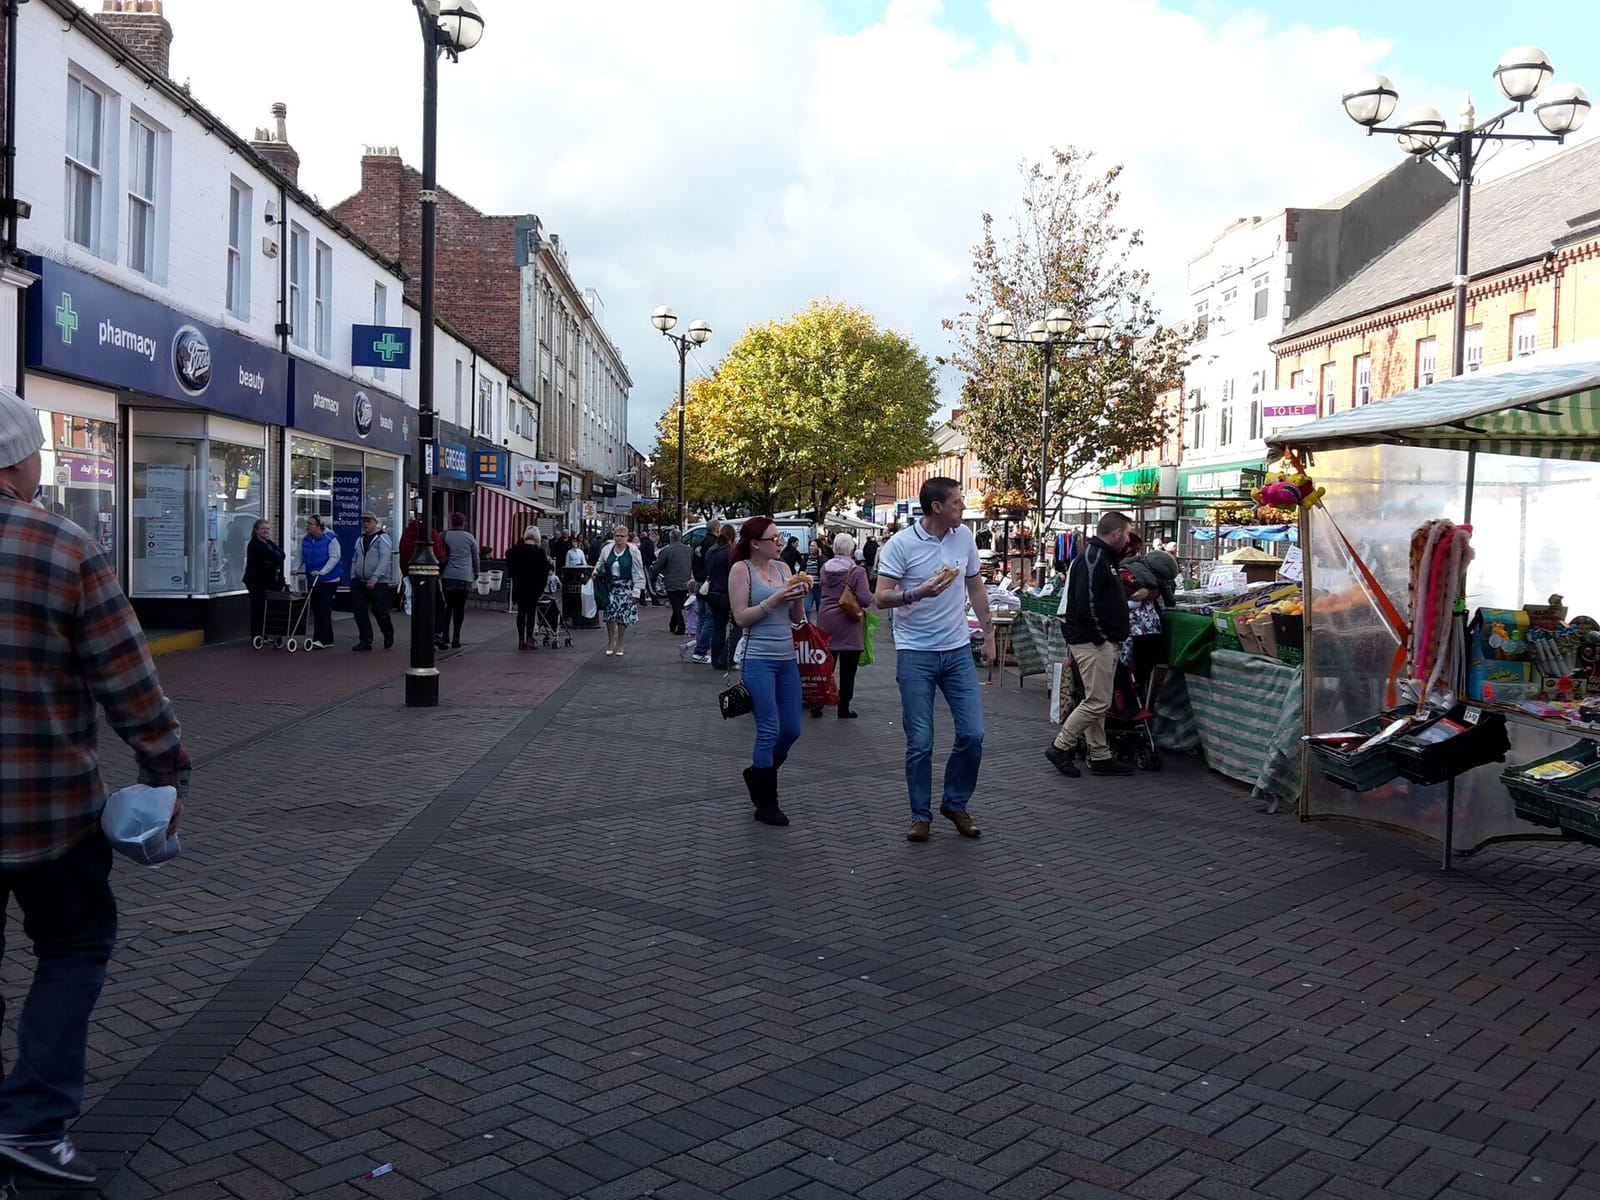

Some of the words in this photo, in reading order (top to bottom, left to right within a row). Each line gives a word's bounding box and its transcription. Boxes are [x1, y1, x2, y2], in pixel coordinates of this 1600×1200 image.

[98, 318, 157, 362] pharmacy
[183, 340, 210, 377] Boots
[238, 365, 265, 395] beauty
[313, 391, 339, 417] pharmacy
[1271, 406, 1286, 416] TO
[1288, 405, 1308, 416] LET
[379, 412, 394, 433] beauty
[332, 476, 359, 484] come
[794, 640, 828, 665] ilko
